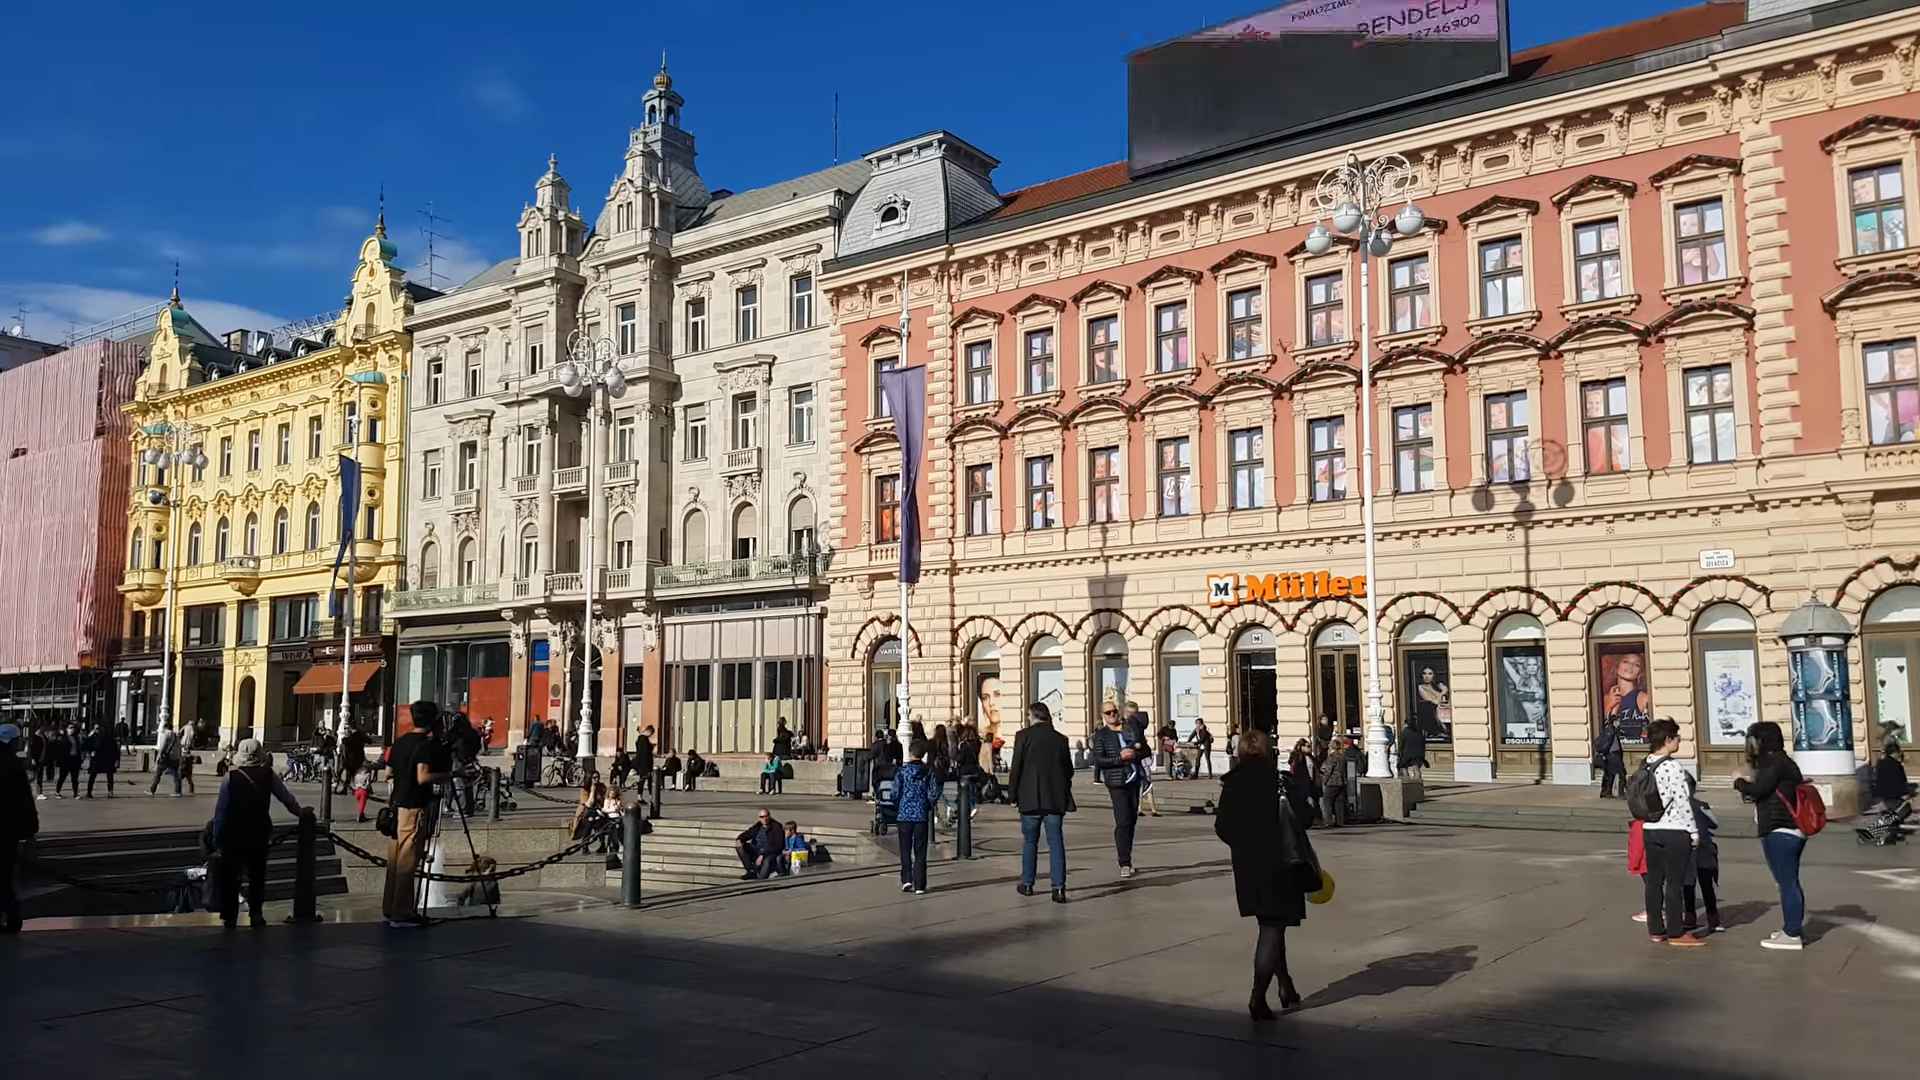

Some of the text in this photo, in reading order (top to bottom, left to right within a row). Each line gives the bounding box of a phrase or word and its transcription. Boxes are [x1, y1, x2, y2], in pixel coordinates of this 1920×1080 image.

[1357, 0, 1480, 36] BENDELJ
[1213, 570, 1367, 602] M Müller
[353, 643, 373, 653] BASLER
